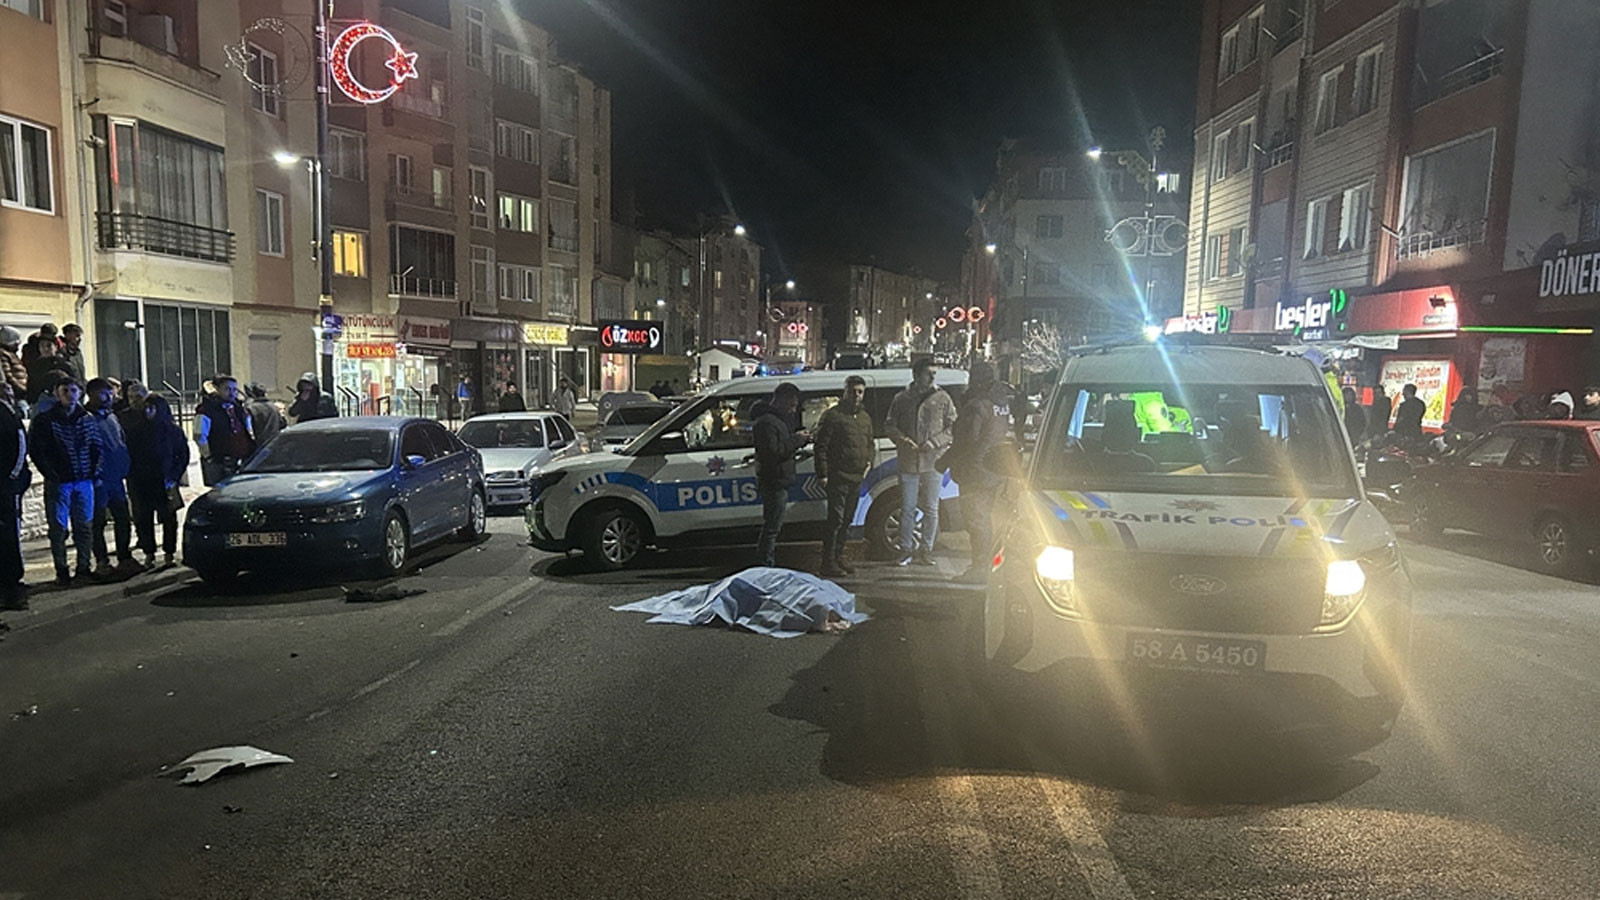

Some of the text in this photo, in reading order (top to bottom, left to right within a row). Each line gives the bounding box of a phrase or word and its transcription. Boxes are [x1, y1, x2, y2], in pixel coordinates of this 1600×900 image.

[678, 480, 758, 507] POLİS
[1133, 639, 1258, 666] 58 A 5450
